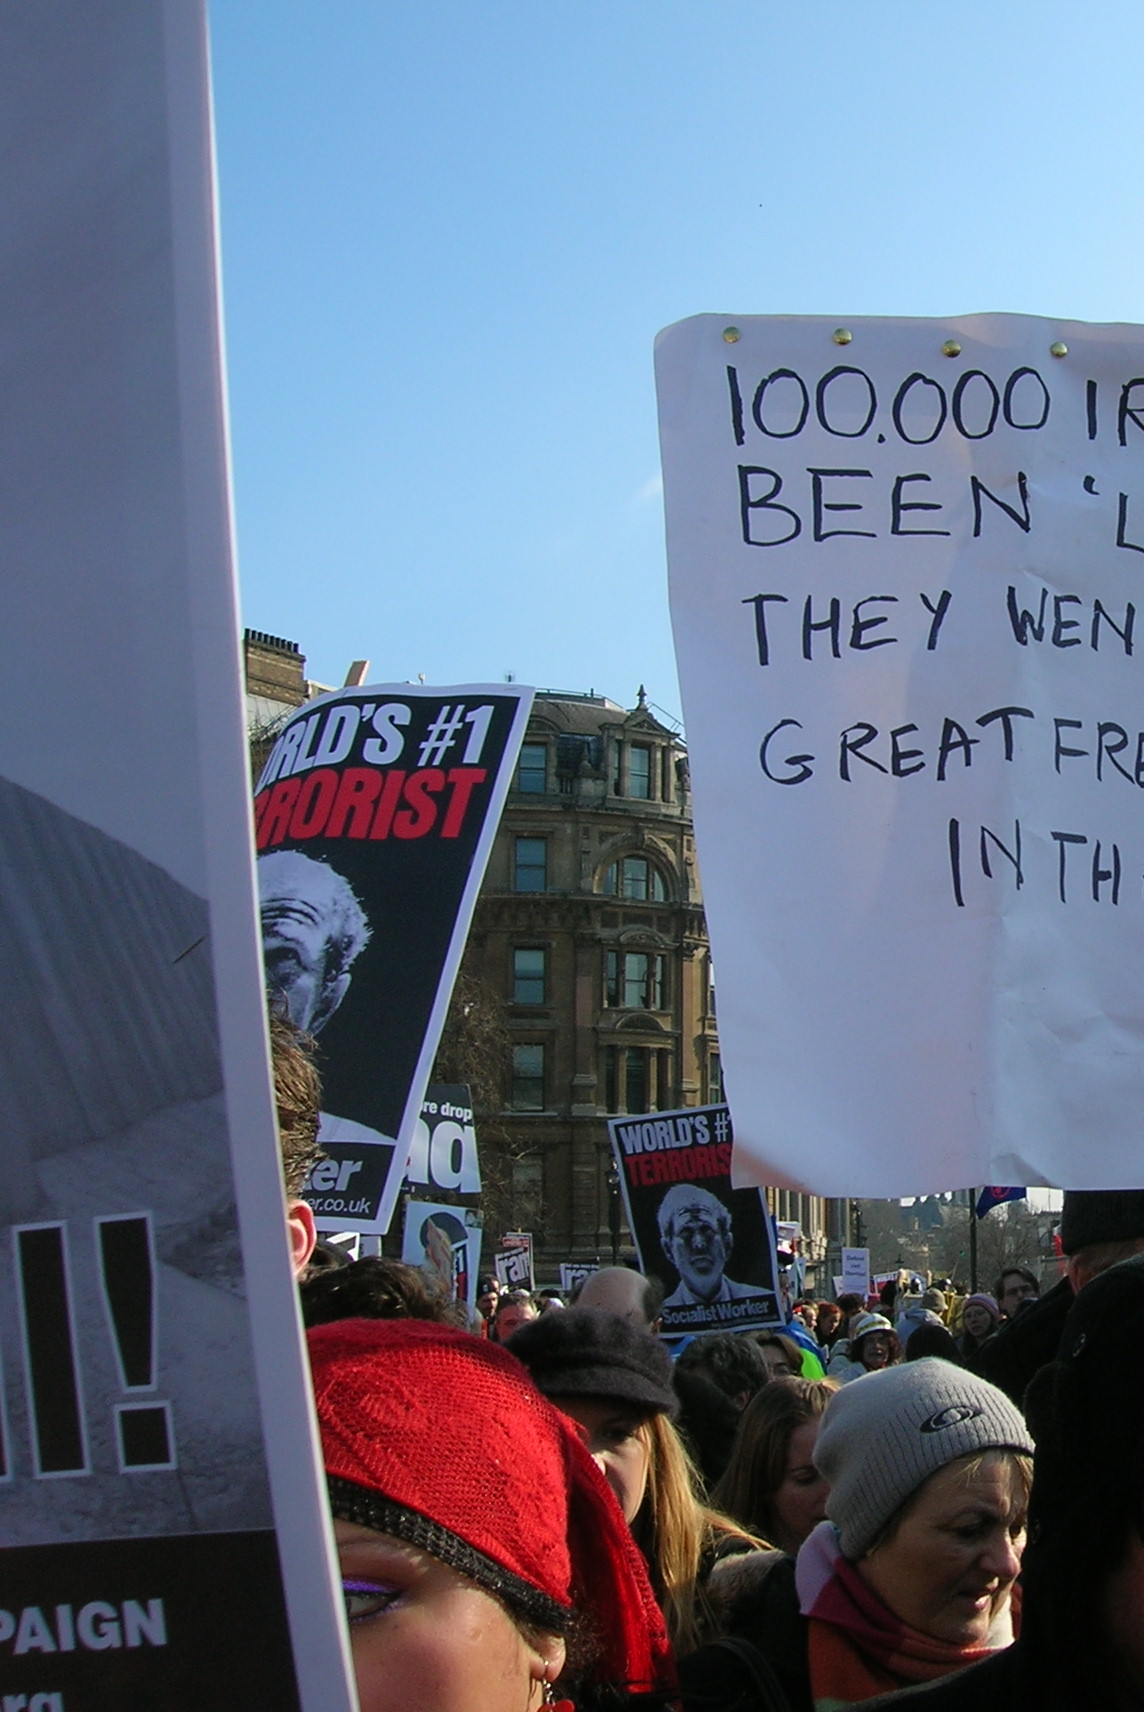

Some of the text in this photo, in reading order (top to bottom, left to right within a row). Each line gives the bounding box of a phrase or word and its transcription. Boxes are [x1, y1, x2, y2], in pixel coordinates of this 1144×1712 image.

[737, 464, 1032, 546] BEEN
[741, 589, 952, 666] THEY
[417, 704, 495, 767] #1
[759, 706, 1034, 785] GREAT
[949, 817, 1024, 907] IN
[440, 1102, 473, 1122] drop
[619, 1115, 710, 1155] WORLD'S
